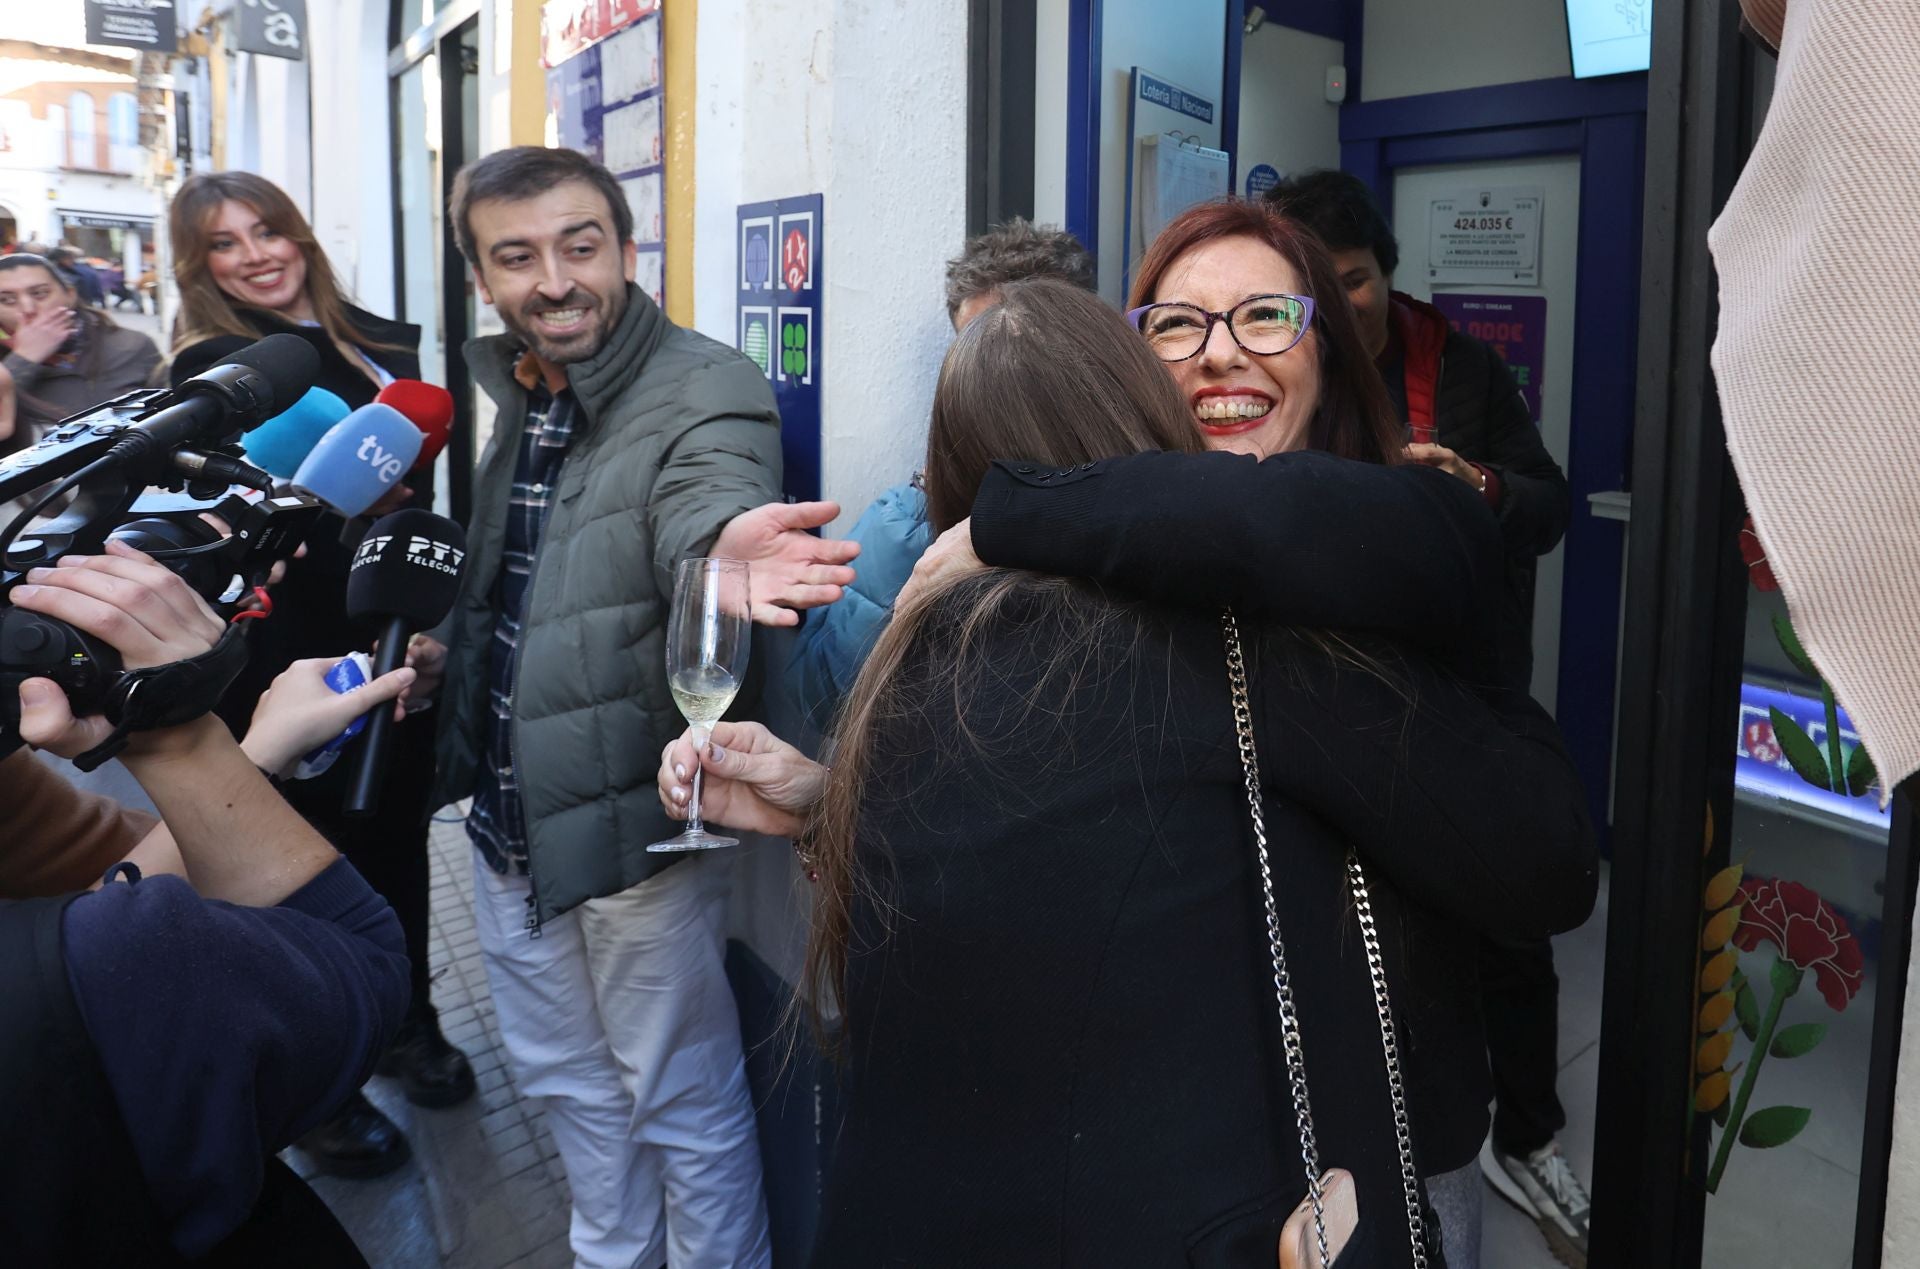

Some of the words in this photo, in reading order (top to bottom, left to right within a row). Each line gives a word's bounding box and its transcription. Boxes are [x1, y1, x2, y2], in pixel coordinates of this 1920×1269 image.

[1182, 96, 1211, 120] Nacional
[1454, 217, 1502, 231] 424.035
[1505, 217, 1513, 230] €
[357, 434, 403, 483] tve
[408, 535, 465, 567] PTV
[406, 553, 458, 577] TELECOM
